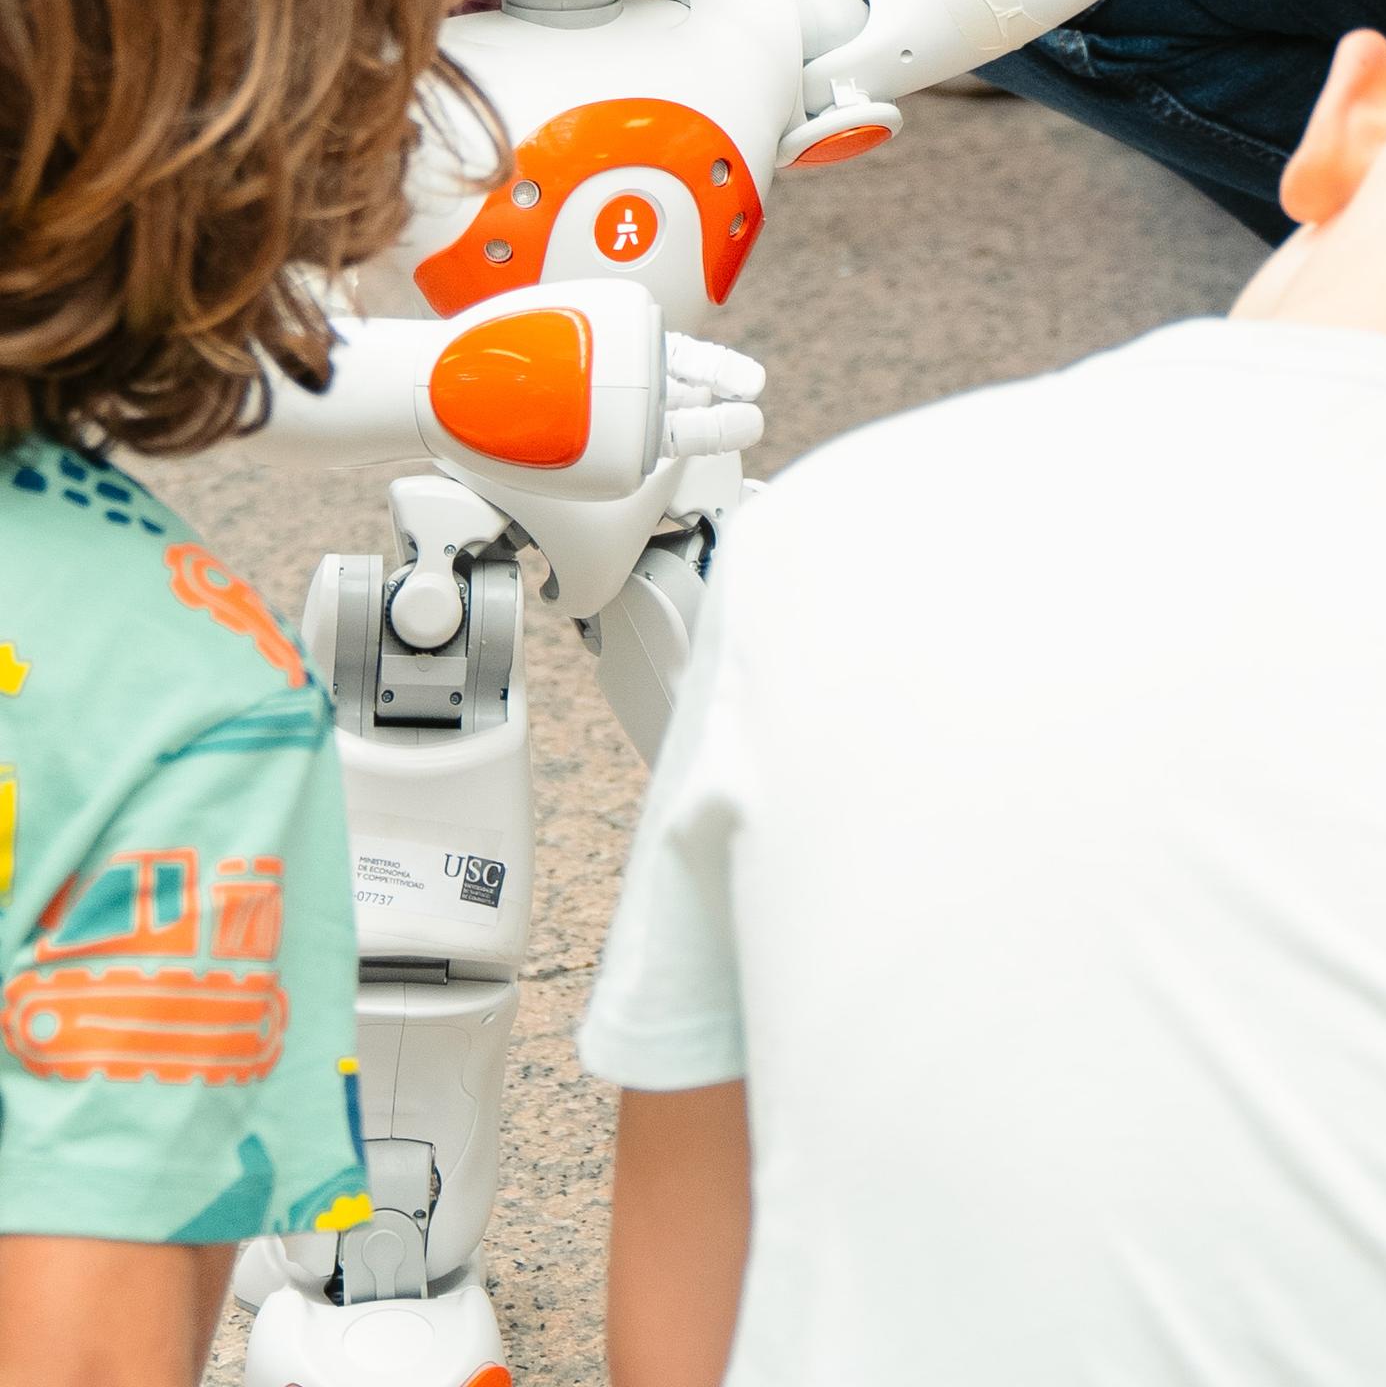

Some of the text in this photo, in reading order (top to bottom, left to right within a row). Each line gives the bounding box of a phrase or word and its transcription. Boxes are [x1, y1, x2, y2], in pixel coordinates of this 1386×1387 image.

[359, 856, 401, 868] MINISTERIO
[445, 853, 502, 888] USC
[362, 873, 425, 890] COMPETITIVIDAD
